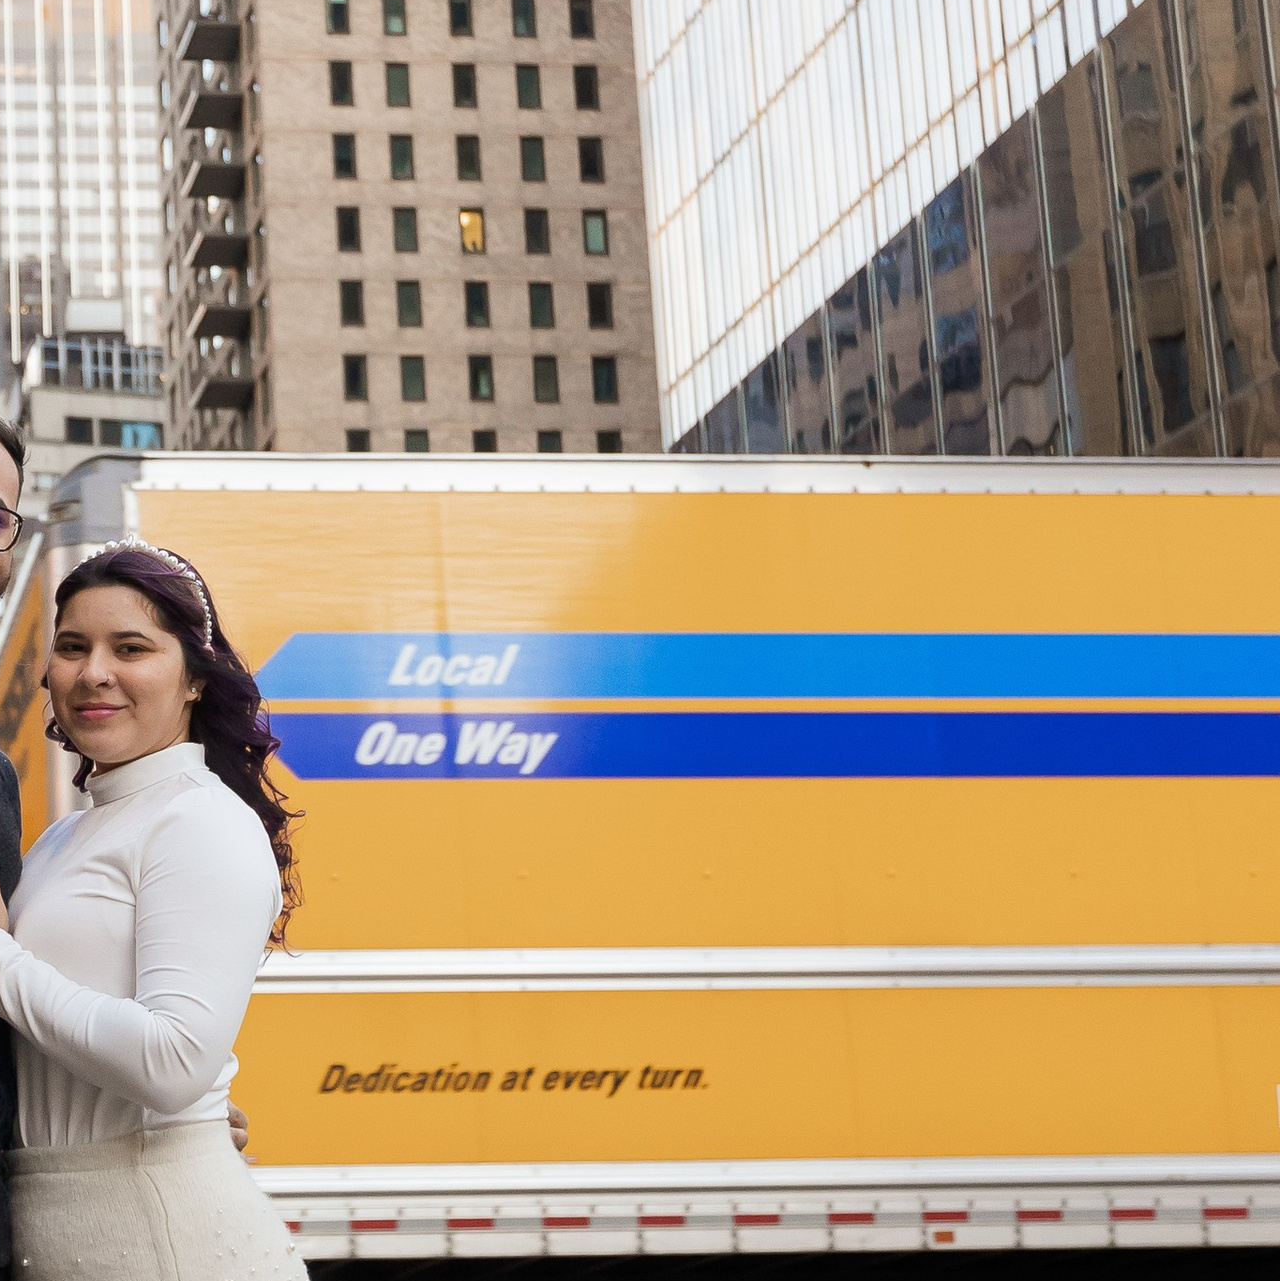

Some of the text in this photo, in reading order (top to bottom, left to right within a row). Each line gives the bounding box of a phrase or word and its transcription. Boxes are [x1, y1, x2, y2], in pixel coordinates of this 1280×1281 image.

[387, 643, 519, 686] Local
[354, 720, 559, 775] One Way
[319, 1064, 709, 1098] Dedication at every turn.
